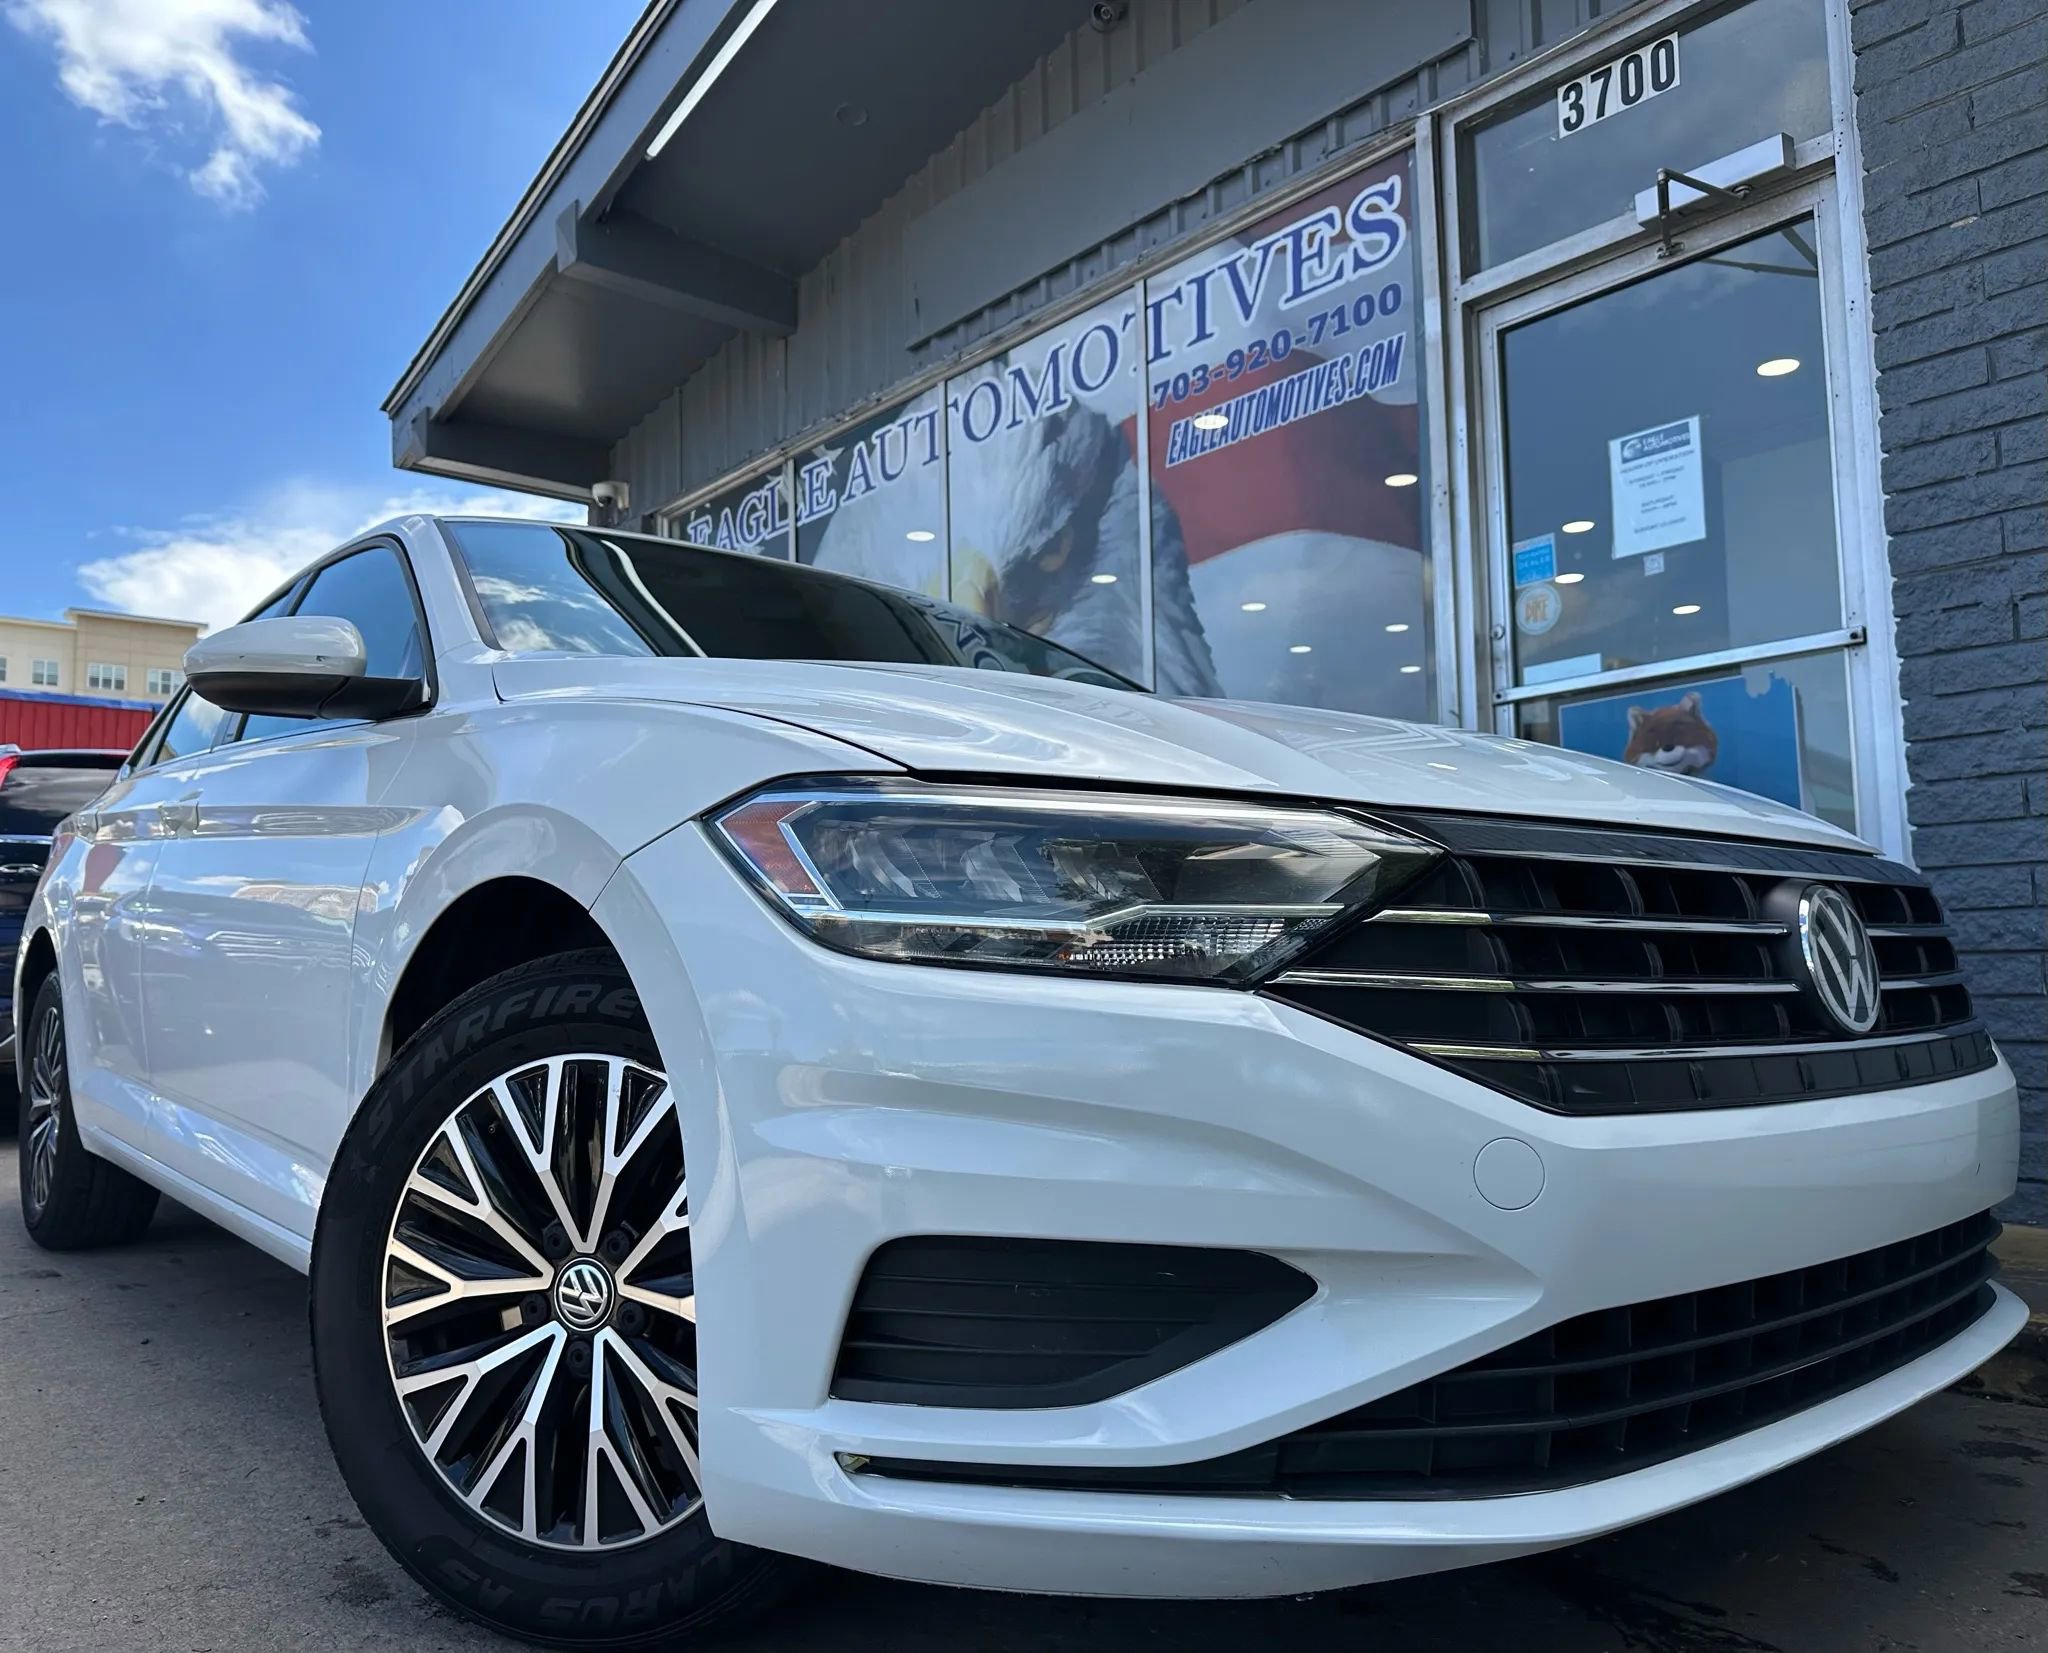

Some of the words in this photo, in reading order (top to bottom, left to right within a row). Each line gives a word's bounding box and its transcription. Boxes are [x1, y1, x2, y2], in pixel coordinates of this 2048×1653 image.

[1562, 38, 1677, 133] 3700
[687, 456, 837, 550] EAGLE
[840, 175, 1406, 504] AUTOMOTIVES
[1153, 282, 1403, 411] 703-920-7100
[1166, 332, 1406, 468] EAGLEAUTOMOTIVES.COM
[1802, 887, 1881, 1034] VW
[367, 983, 641, 1137] STARFIRE
[540, 1545, 732, 1630] LARUS
